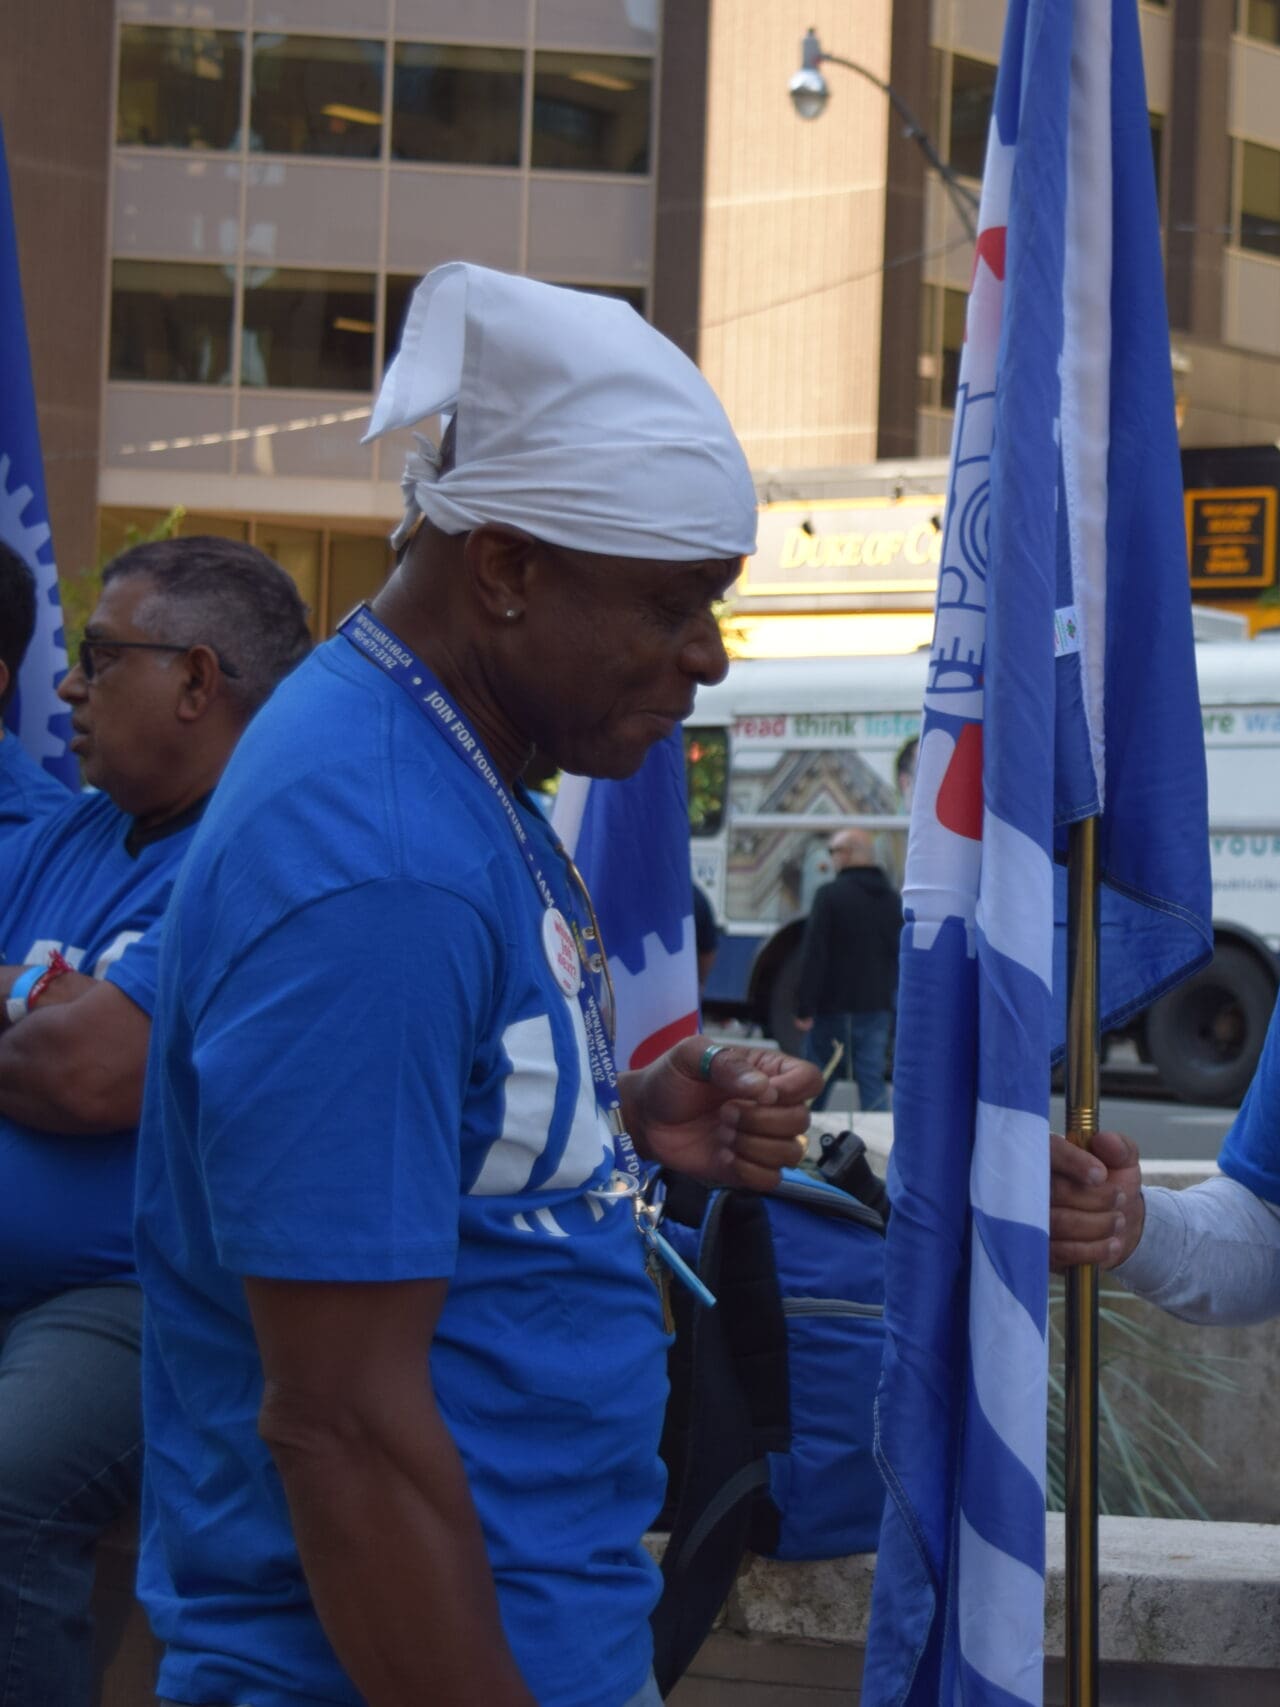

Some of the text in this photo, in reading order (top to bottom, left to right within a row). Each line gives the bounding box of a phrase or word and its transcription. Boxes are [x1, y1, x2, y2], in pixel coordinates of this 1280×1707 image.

[424, 691, 457, 724] JOIN
[451, 720, 476, 752] FOR
[473, 749, 499, 788] YOUR
[497, 786, 527, 844] FUTURE
[735, 712, 920, 737] read think liste
